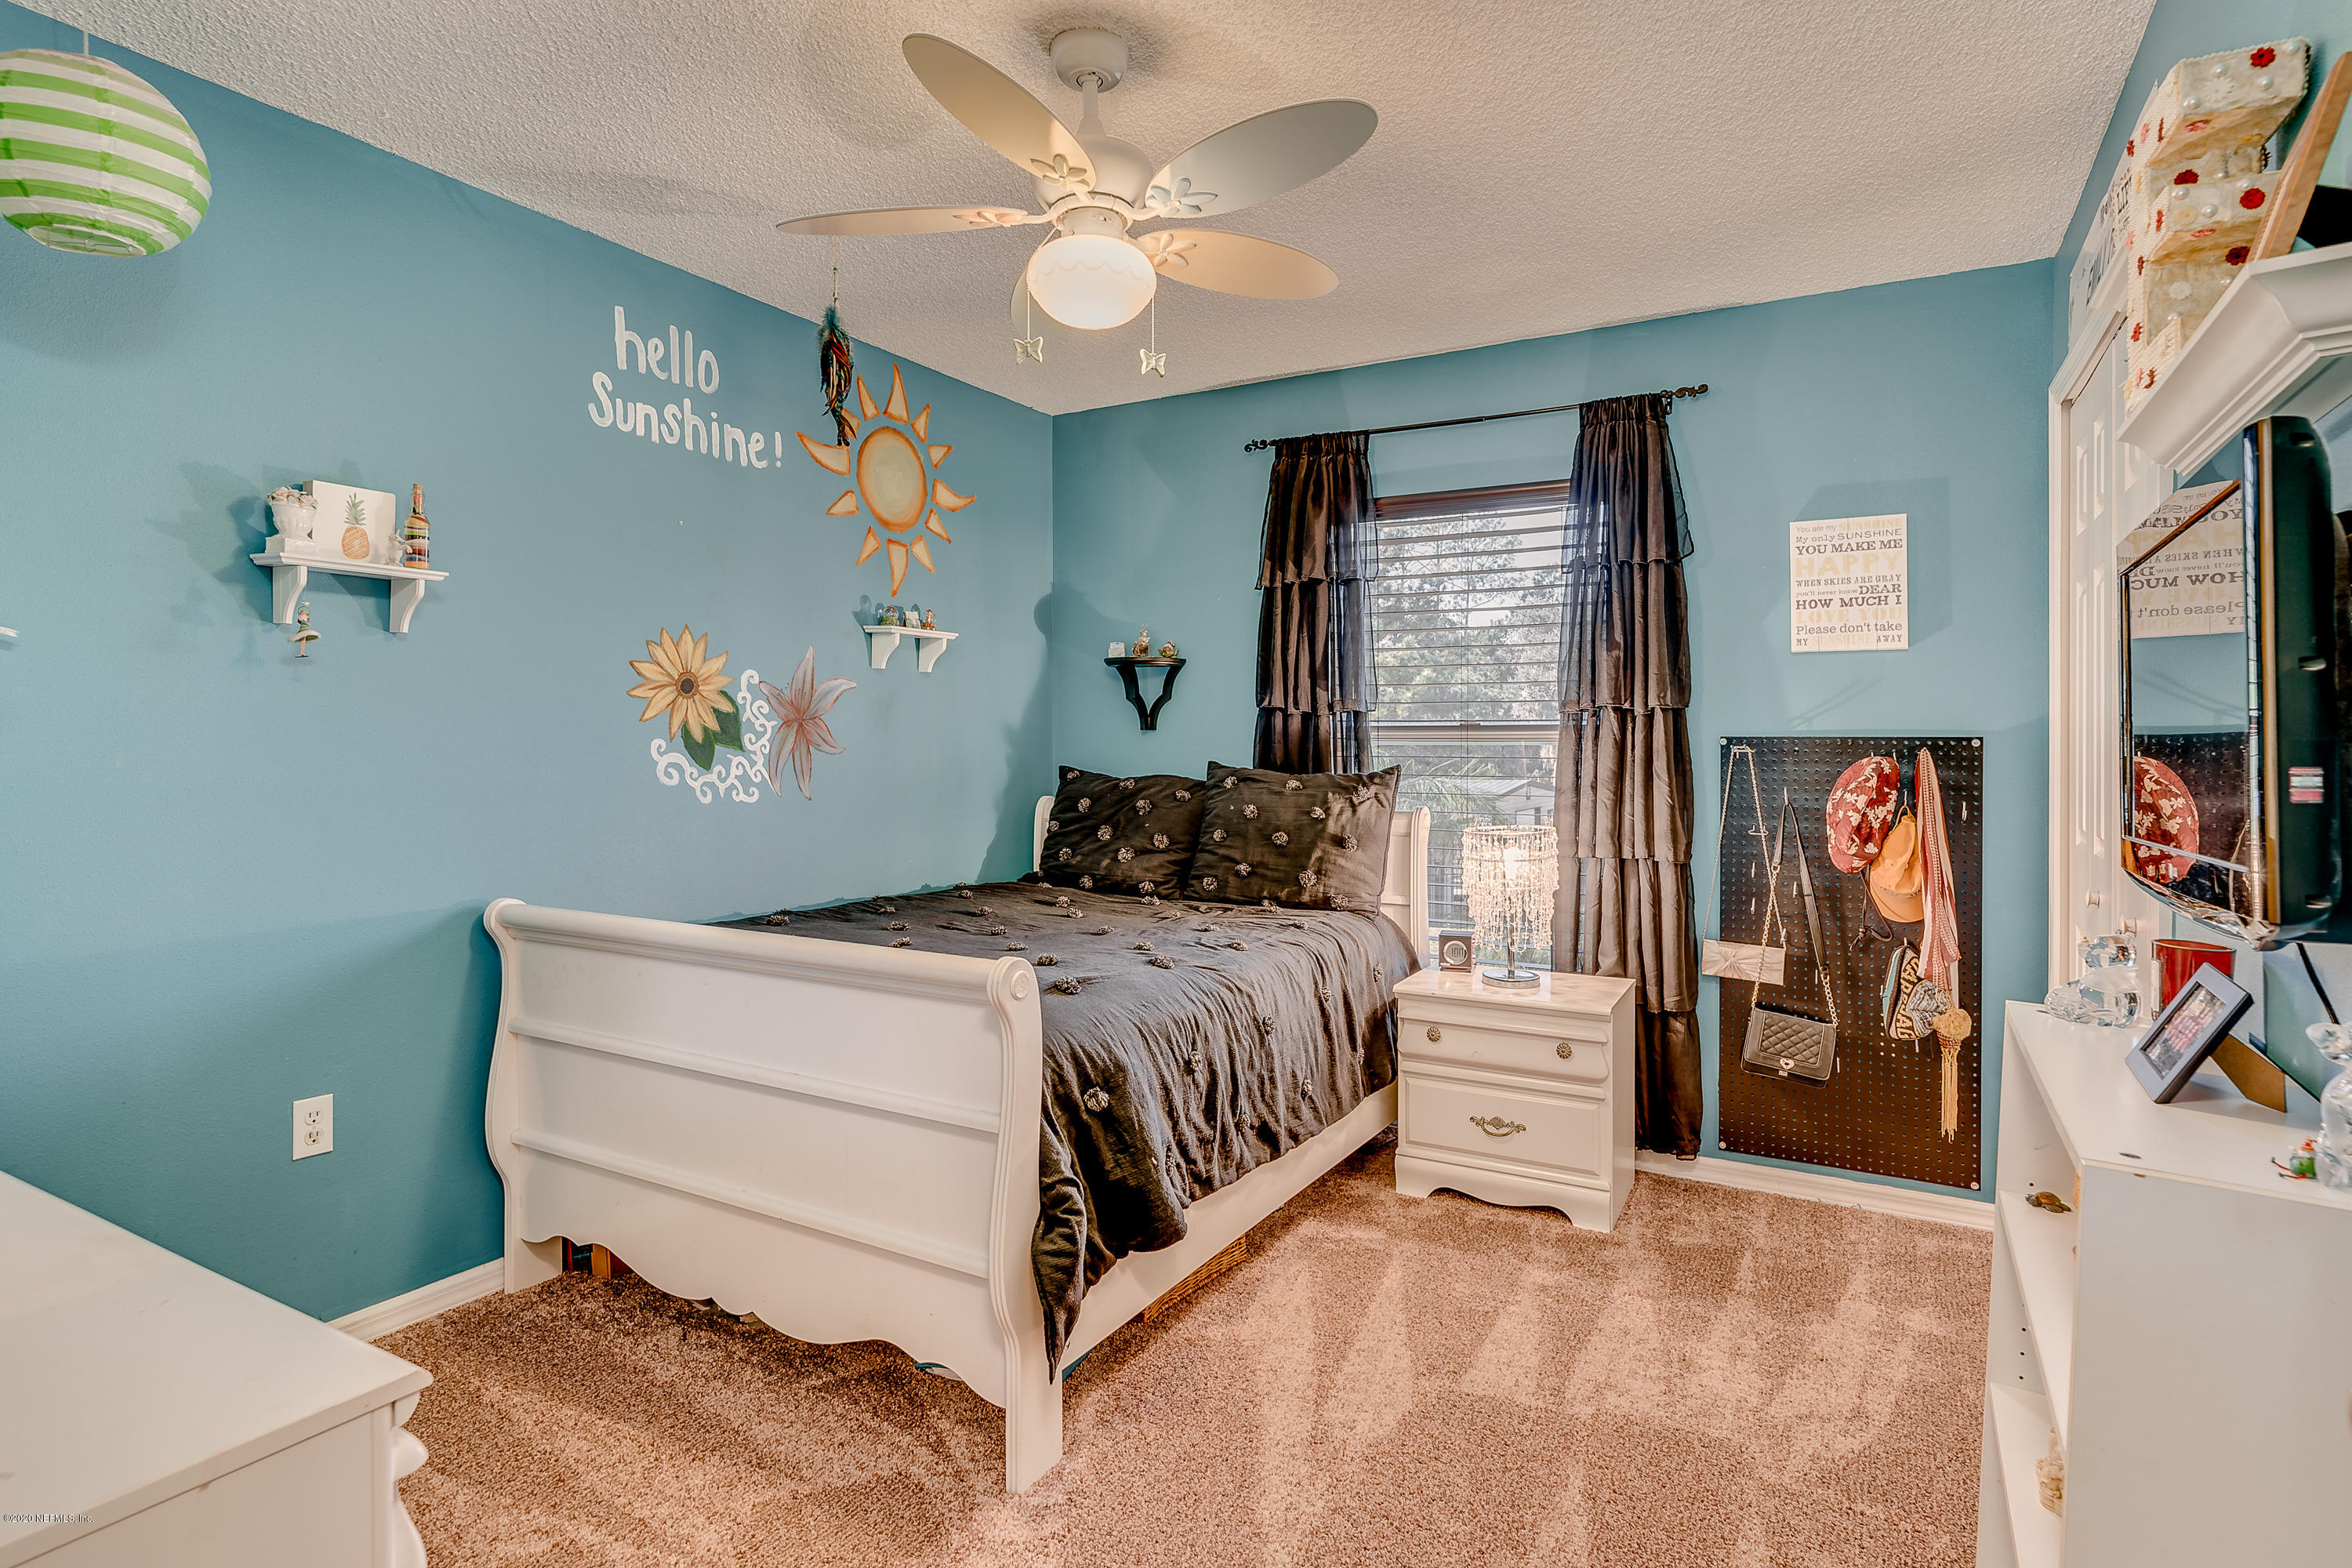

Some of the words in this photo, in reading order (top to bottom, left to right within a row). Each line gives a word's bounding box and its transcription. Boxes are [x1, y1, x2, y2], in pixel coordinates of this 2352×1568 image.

[614, 306, 720, 394] hello
[588, 372, 782, 469] Sunshine!
[1838, 518, 1901, 532] SUNSHINE
[1811, 534, 1835, 543] only
[1837, 528, 1903, 540] SUNSHINE
[1795, 544, 1828, 556] YOU
[1831, 540, 1876, 554] MAKE
[1878, 539, 1903, 550] ME
[1795, 551, 1901, 578] HAPPY
[1796, 579, 1823, 587] WHEN
[1824, 577, 1852, 586] SKIES
[1854, 575, 1873, 584] ARE
[1875, 574, 1902, 583] GRAY
[1858, 583, 1902, 595] DEAR
[1795, 598, 1834, 610] HOW
[1839, 595, 1889, 608] MUCH
[1895, 595, 1902, 604] I
[1795, 609, 1849, 624] LOVE
[1858, 606, 1902, 622] YOU
[1796, 624, 1837, 635] Please
[1839, 622, 1871, 633] don't
[1875, 621, 1903, 632] take
[1813, 633, 1872, 646] SUNSHINE
[1877, 634, 1903, 644] AWAY
